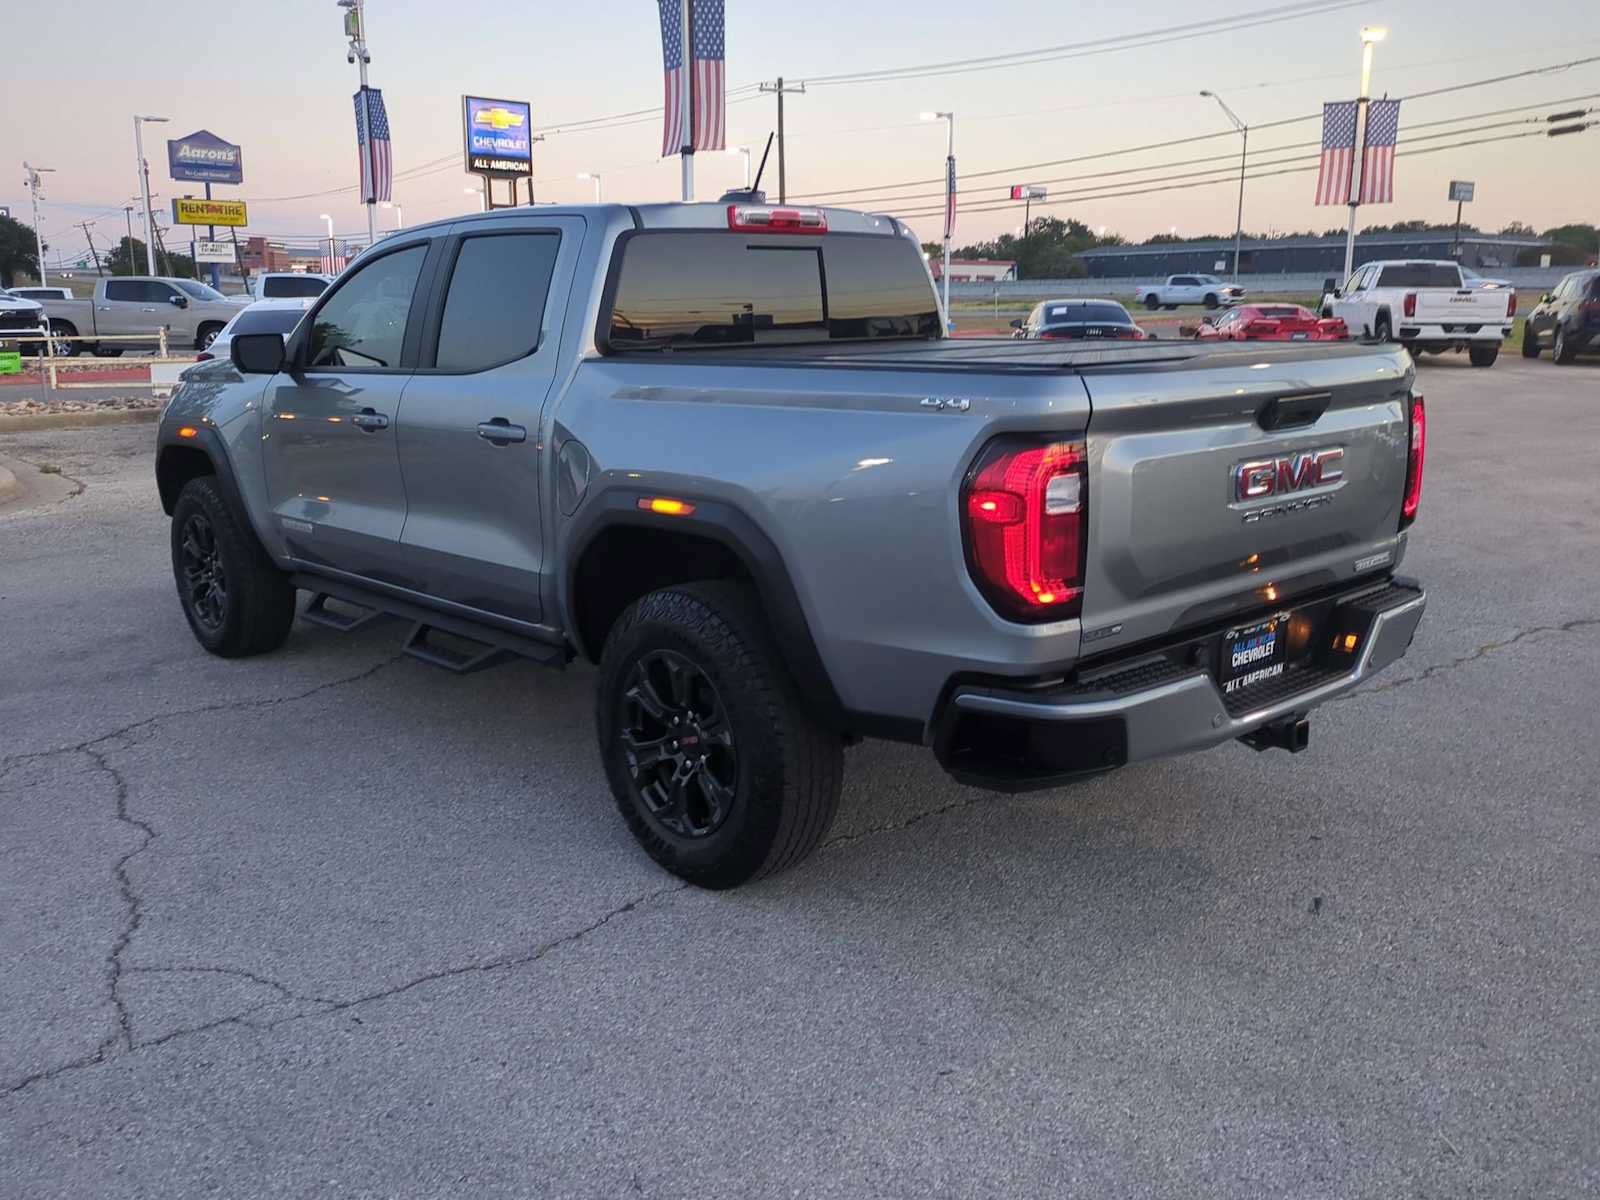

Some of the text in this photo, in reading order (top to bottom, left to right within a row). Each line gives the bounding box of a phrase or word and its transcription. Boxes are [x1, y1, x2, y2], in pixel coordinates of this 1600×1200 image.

[473, 136, 528, 149] CHEVROLET
[474, 159, 529, 171] ALL AMERICAN
[1230, 447, 1345, 501] GMC
[1231, 640, 1276, 668] CHEVROLET
[1242, 662, 1285, 687] AMERICAN
